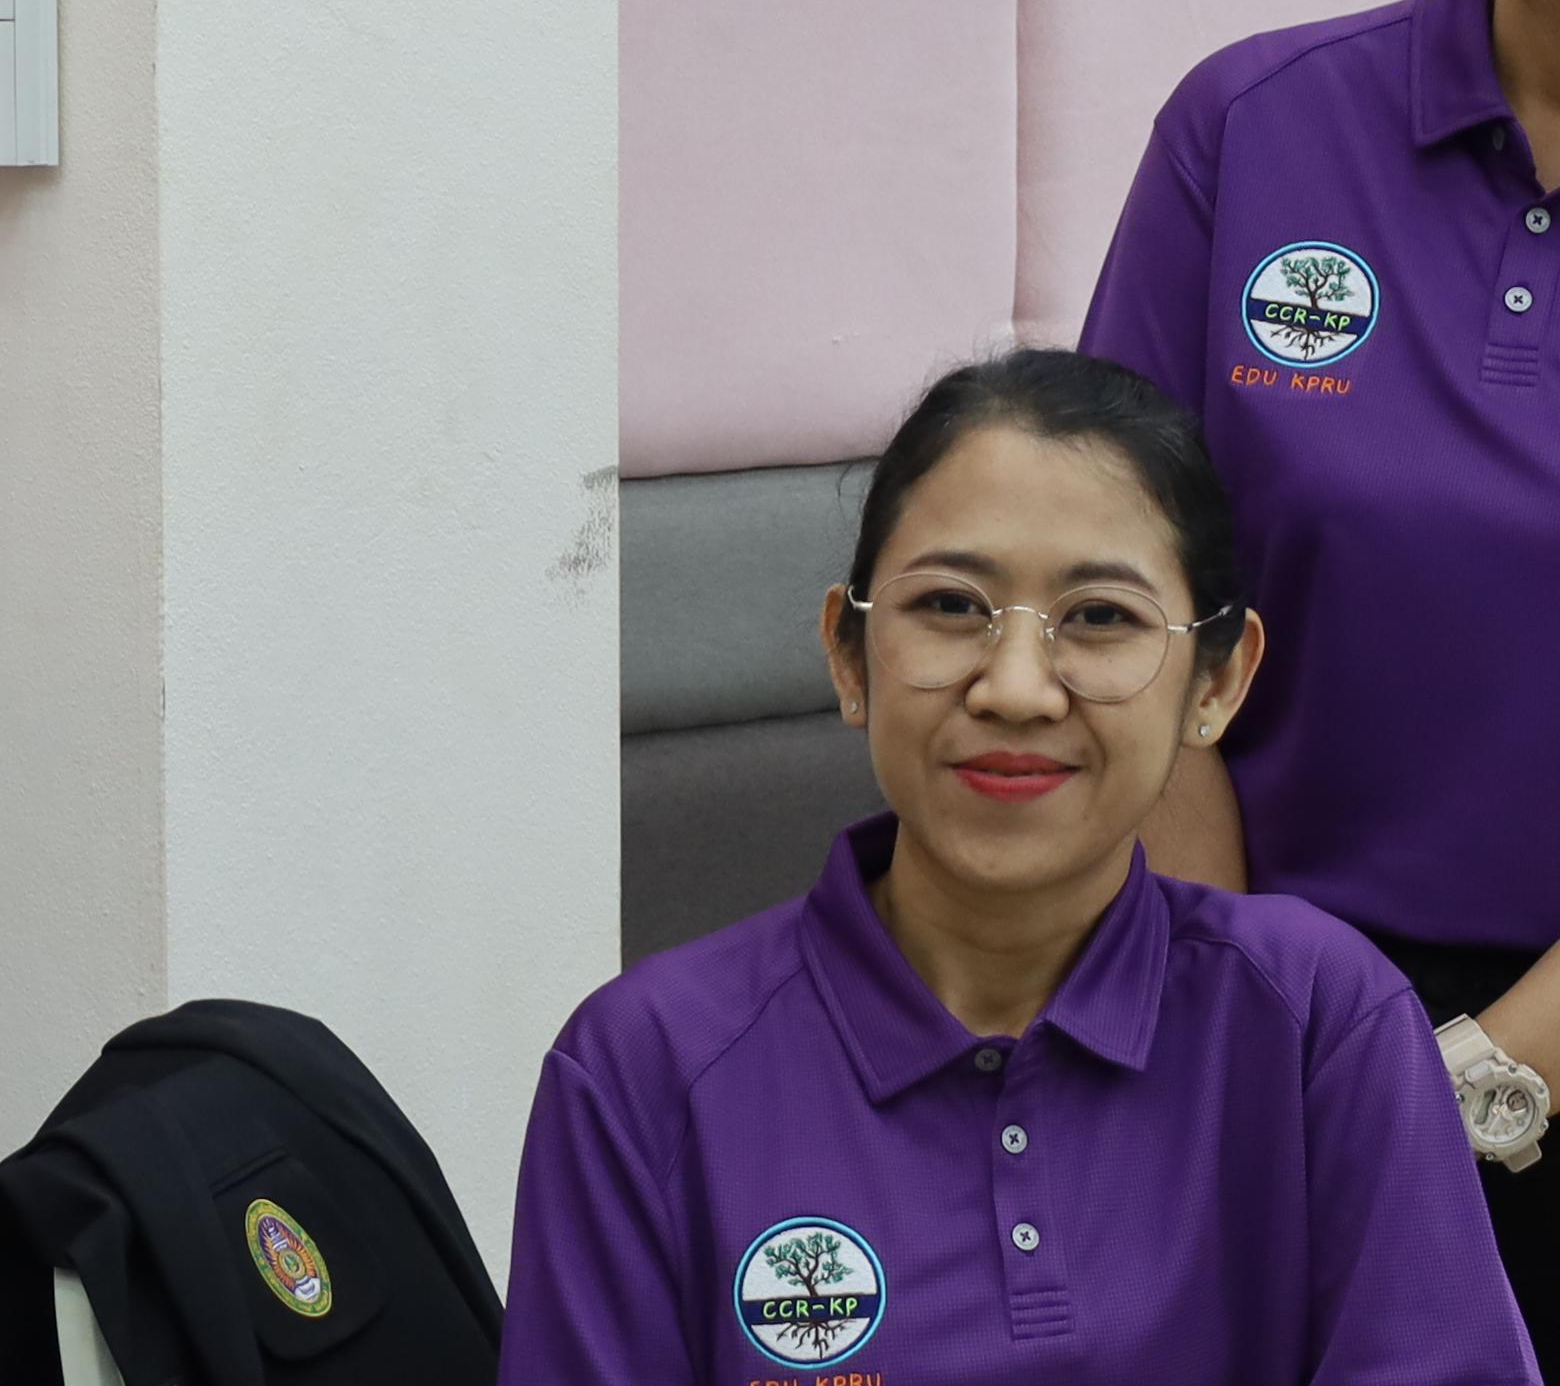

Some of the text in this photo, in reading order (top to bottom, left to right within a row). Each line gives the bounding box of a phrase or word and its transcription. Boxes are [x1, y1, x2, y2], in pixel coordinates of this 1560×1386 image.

[1264, 303, 1351, 331] CCR-KP
[1230, 365, 1351, 395] EDU KPRU
[763, 1297, 859, 1319] CCR-KP
